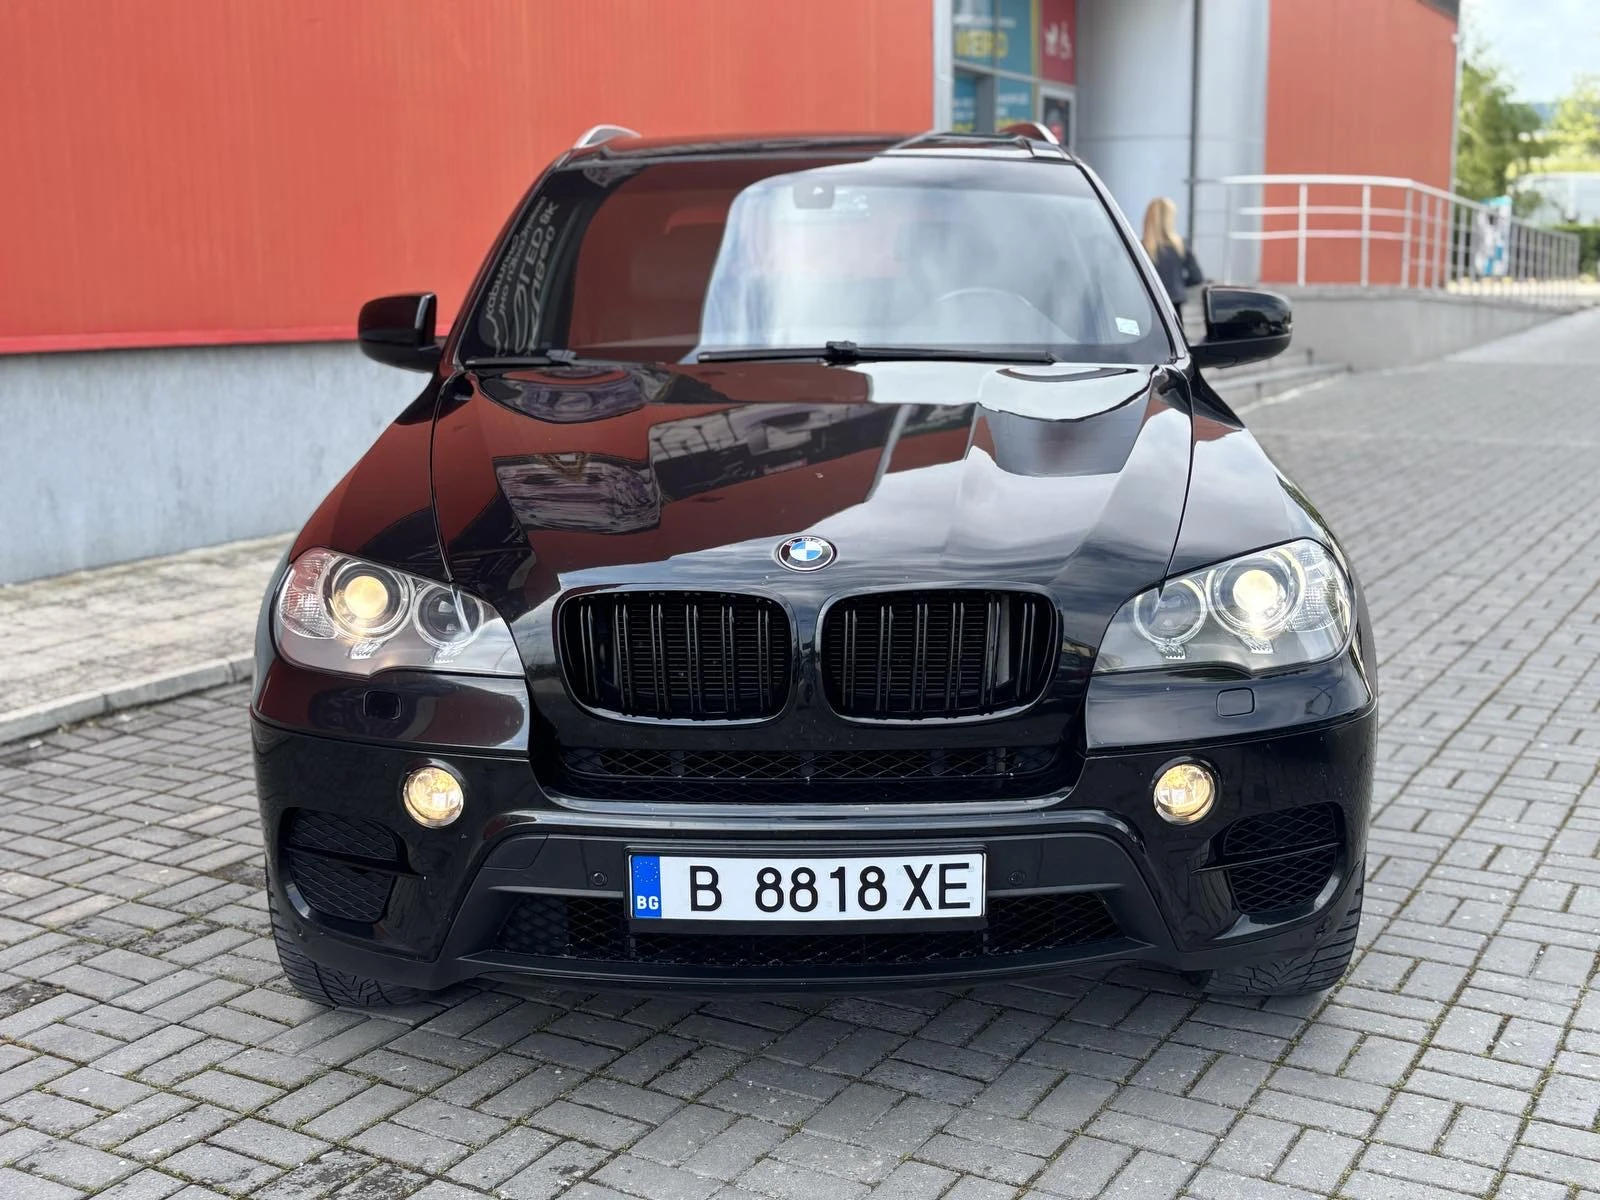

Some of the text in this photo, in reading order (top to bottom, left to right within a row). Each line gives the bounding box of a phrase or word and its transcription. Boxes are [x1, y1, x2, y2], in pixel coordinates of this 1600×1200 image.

[636, 896, 659, 909] BG
[690, 862, 971, 912] B 8818 XE
